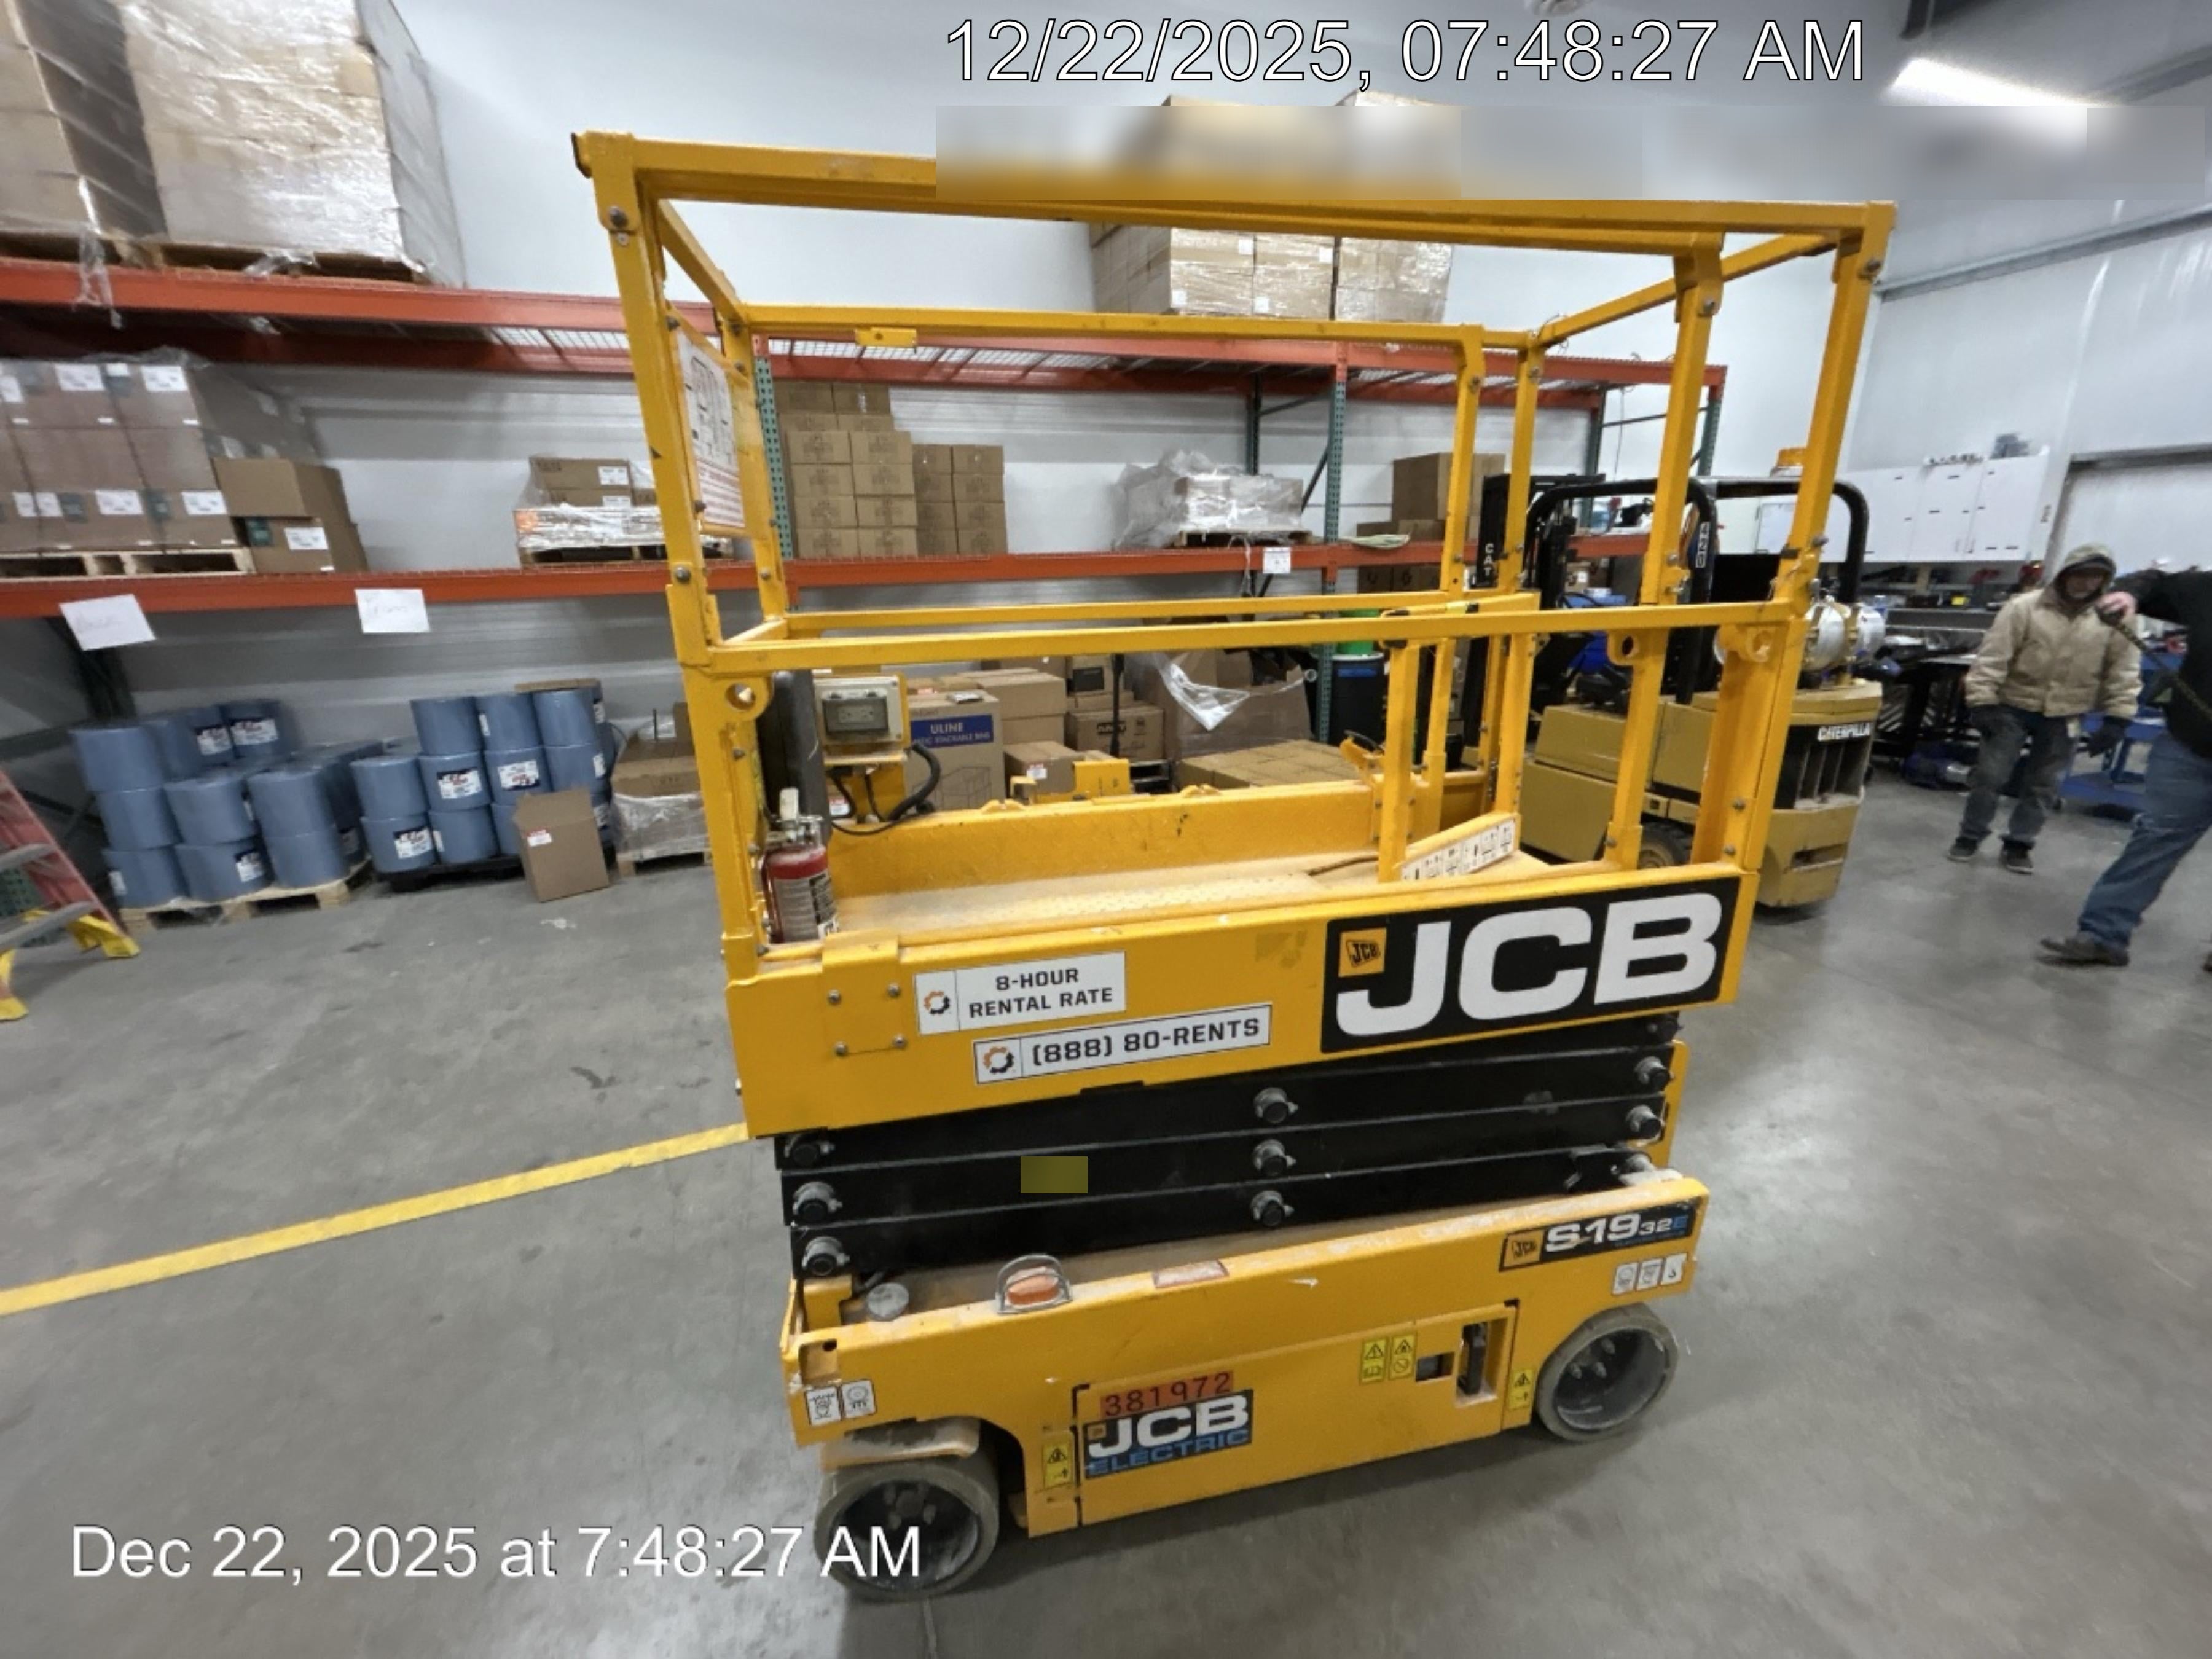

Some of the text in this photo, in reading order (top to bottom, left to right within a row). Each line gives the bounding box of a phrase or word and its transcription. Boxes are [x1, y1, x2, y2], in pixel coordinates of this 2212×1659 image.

[1483, 542, 1495, 577] CAT
[930, 722, 964, 735] ULINE
[1335, 893, 1723, 1037] JCB
[1352, 943, 1381, 965] JCB
[995, 968, 1079, 991] 8-HOUR
[969, 987, 1113, 1018] RENTAL RATE
[1032, 1017, 1260, 1066] (888) 80-RENTS
[1105, 1371, 1231, 1417] 381972
[1088, 1394, 1249, 1458] JCB
[1086, 1428, 1250, 1476] ELECTRIC
